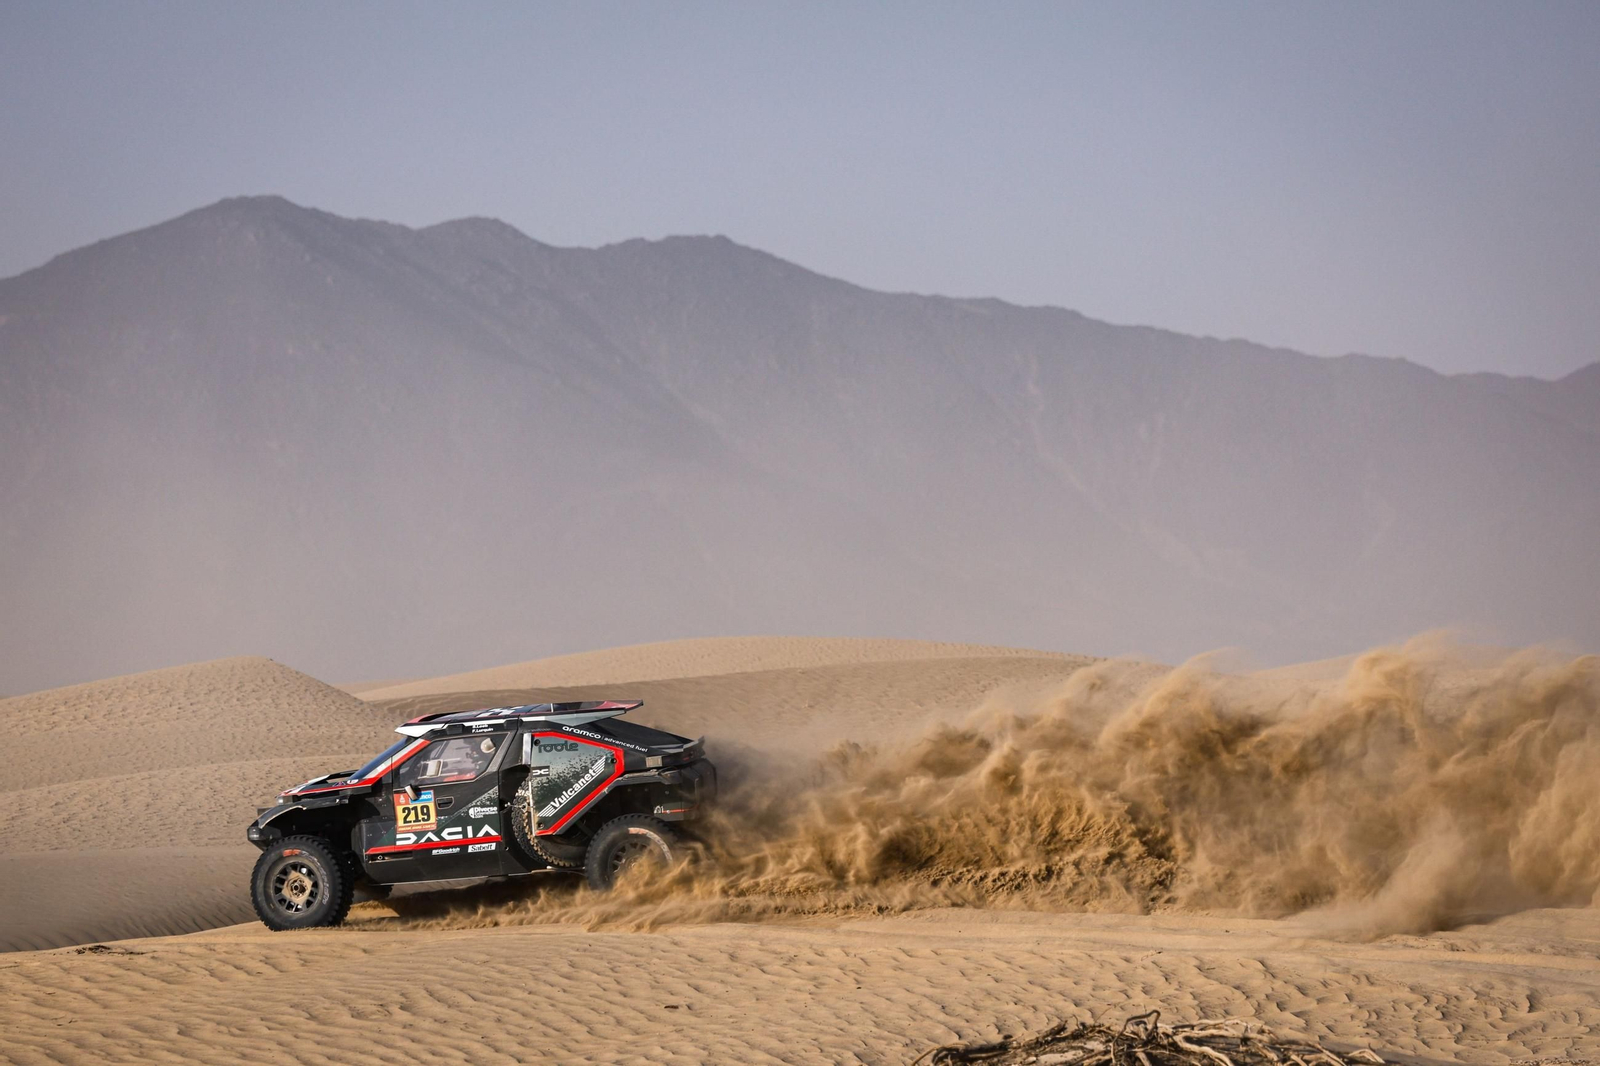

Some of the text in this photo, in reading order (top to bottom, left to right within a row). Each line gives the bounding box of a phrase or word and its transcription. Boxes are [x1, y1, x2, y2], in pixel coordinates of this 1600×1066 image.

[538, 740, 579, 753] roole
[562, 725, 649, 753] aramco advanced fuel
[550, 768, 597, 810] Vulcanet
[402, 804, 431, 824] 219
[396, 824, 499, 846] DACIA
[471, 844, 493, 852] Sabelt
